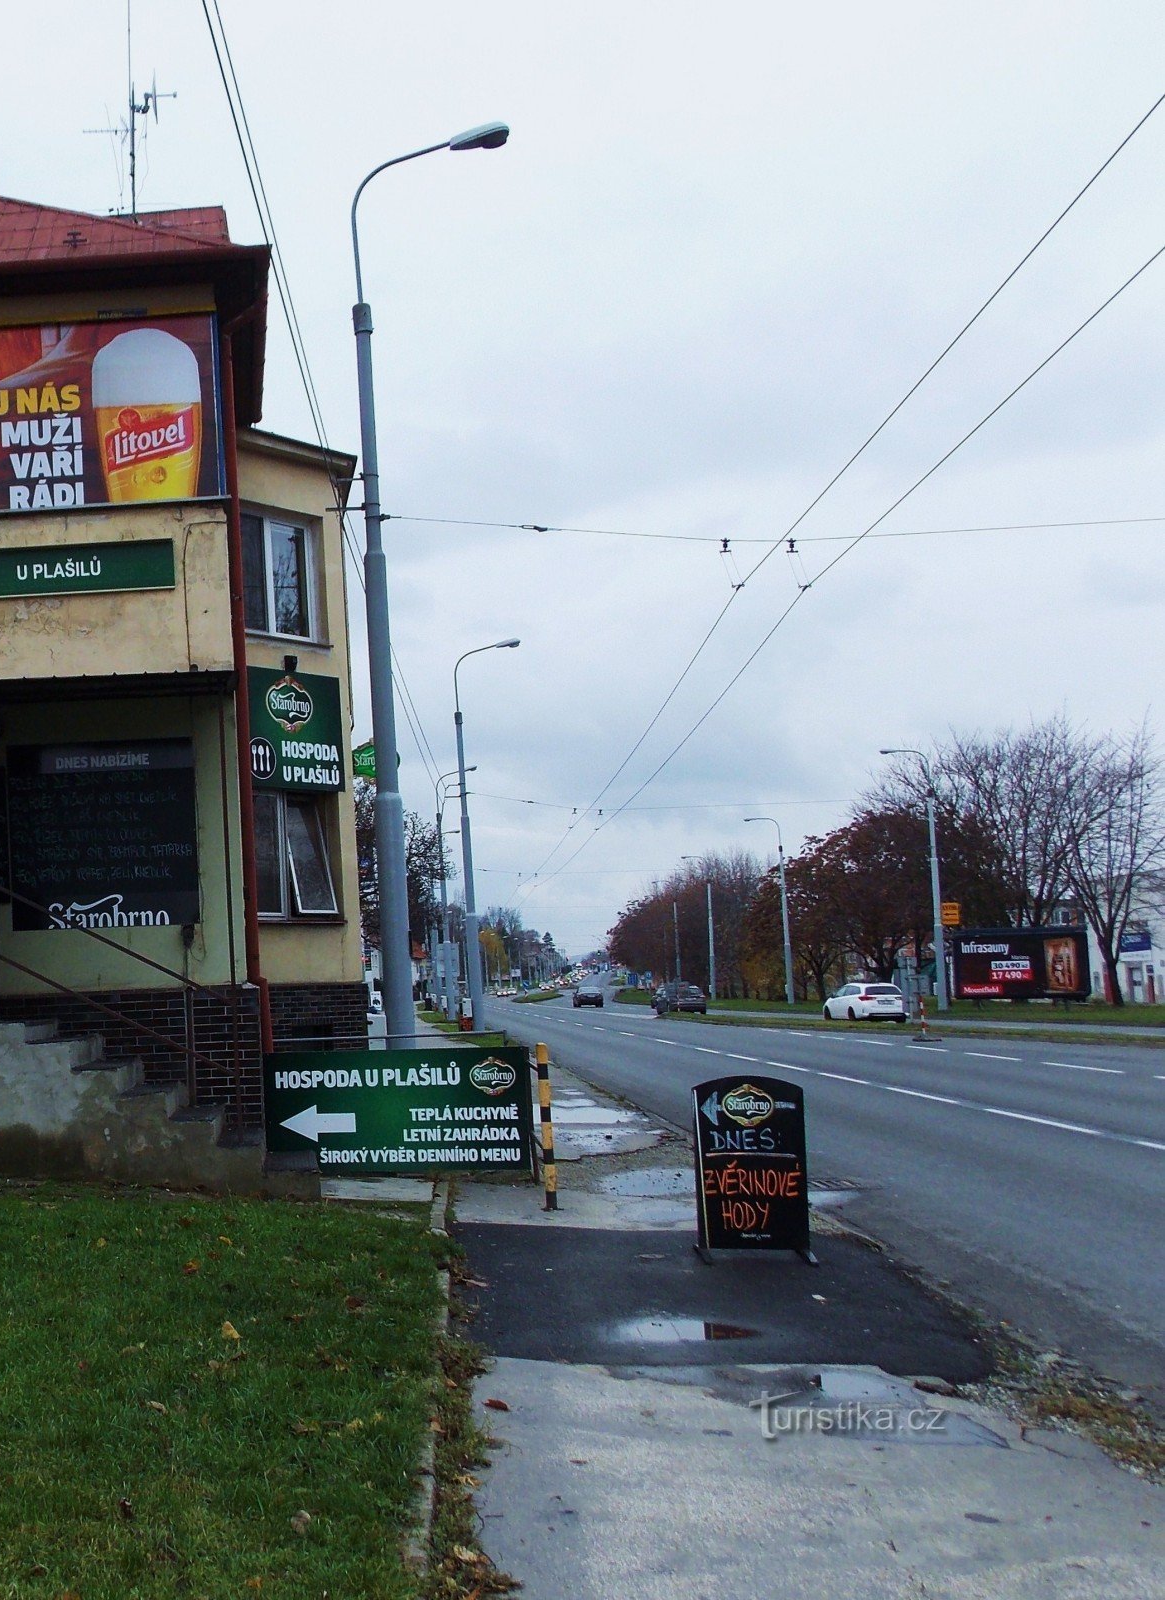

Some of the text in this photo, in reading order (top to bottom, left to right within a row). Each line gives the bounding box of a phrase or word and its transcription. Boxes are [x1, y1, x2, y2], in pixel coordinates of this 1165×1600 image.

[18, 383, 81, 414] NÁS
[1, 414, 83, 447] MUŽI
[114, 415, 186, 465] Litovel
[9, 444, 84, 480] VAŘÍ
[9, 481, 85, 510] RÁDI
[16, 555, 101, 581] U PLAŠILŮ
[270, 692, 310, 718] Starobrno
[55, 752, 150, 770] DNES NABÍZÍME
[281, 740, 339, 762] HOSPODA
[283, 765, 339, 785] U PLAŠILŮ
[961, 941, 1009, 955] Infrasauny
[1005, 971, 1021, 979] 490
[275, 1062, 461, 1089] HOSPODA U PLAŠILŮ
[474, 1067, 513, 1084] Starobrno
[409, 1103, 519, 1121] TEPLÁ KUCHYNĚ
[728, 1096, 770, 1115] Starobrno
[403, 1125, 520, 1142] LETNÍ ZAHRÁDKA
[320, 1145, 521, 1164] ŠIROKÝ VÝBĚR DENNÍHO MENU
[722, 1200, 769, 1230] HODY
